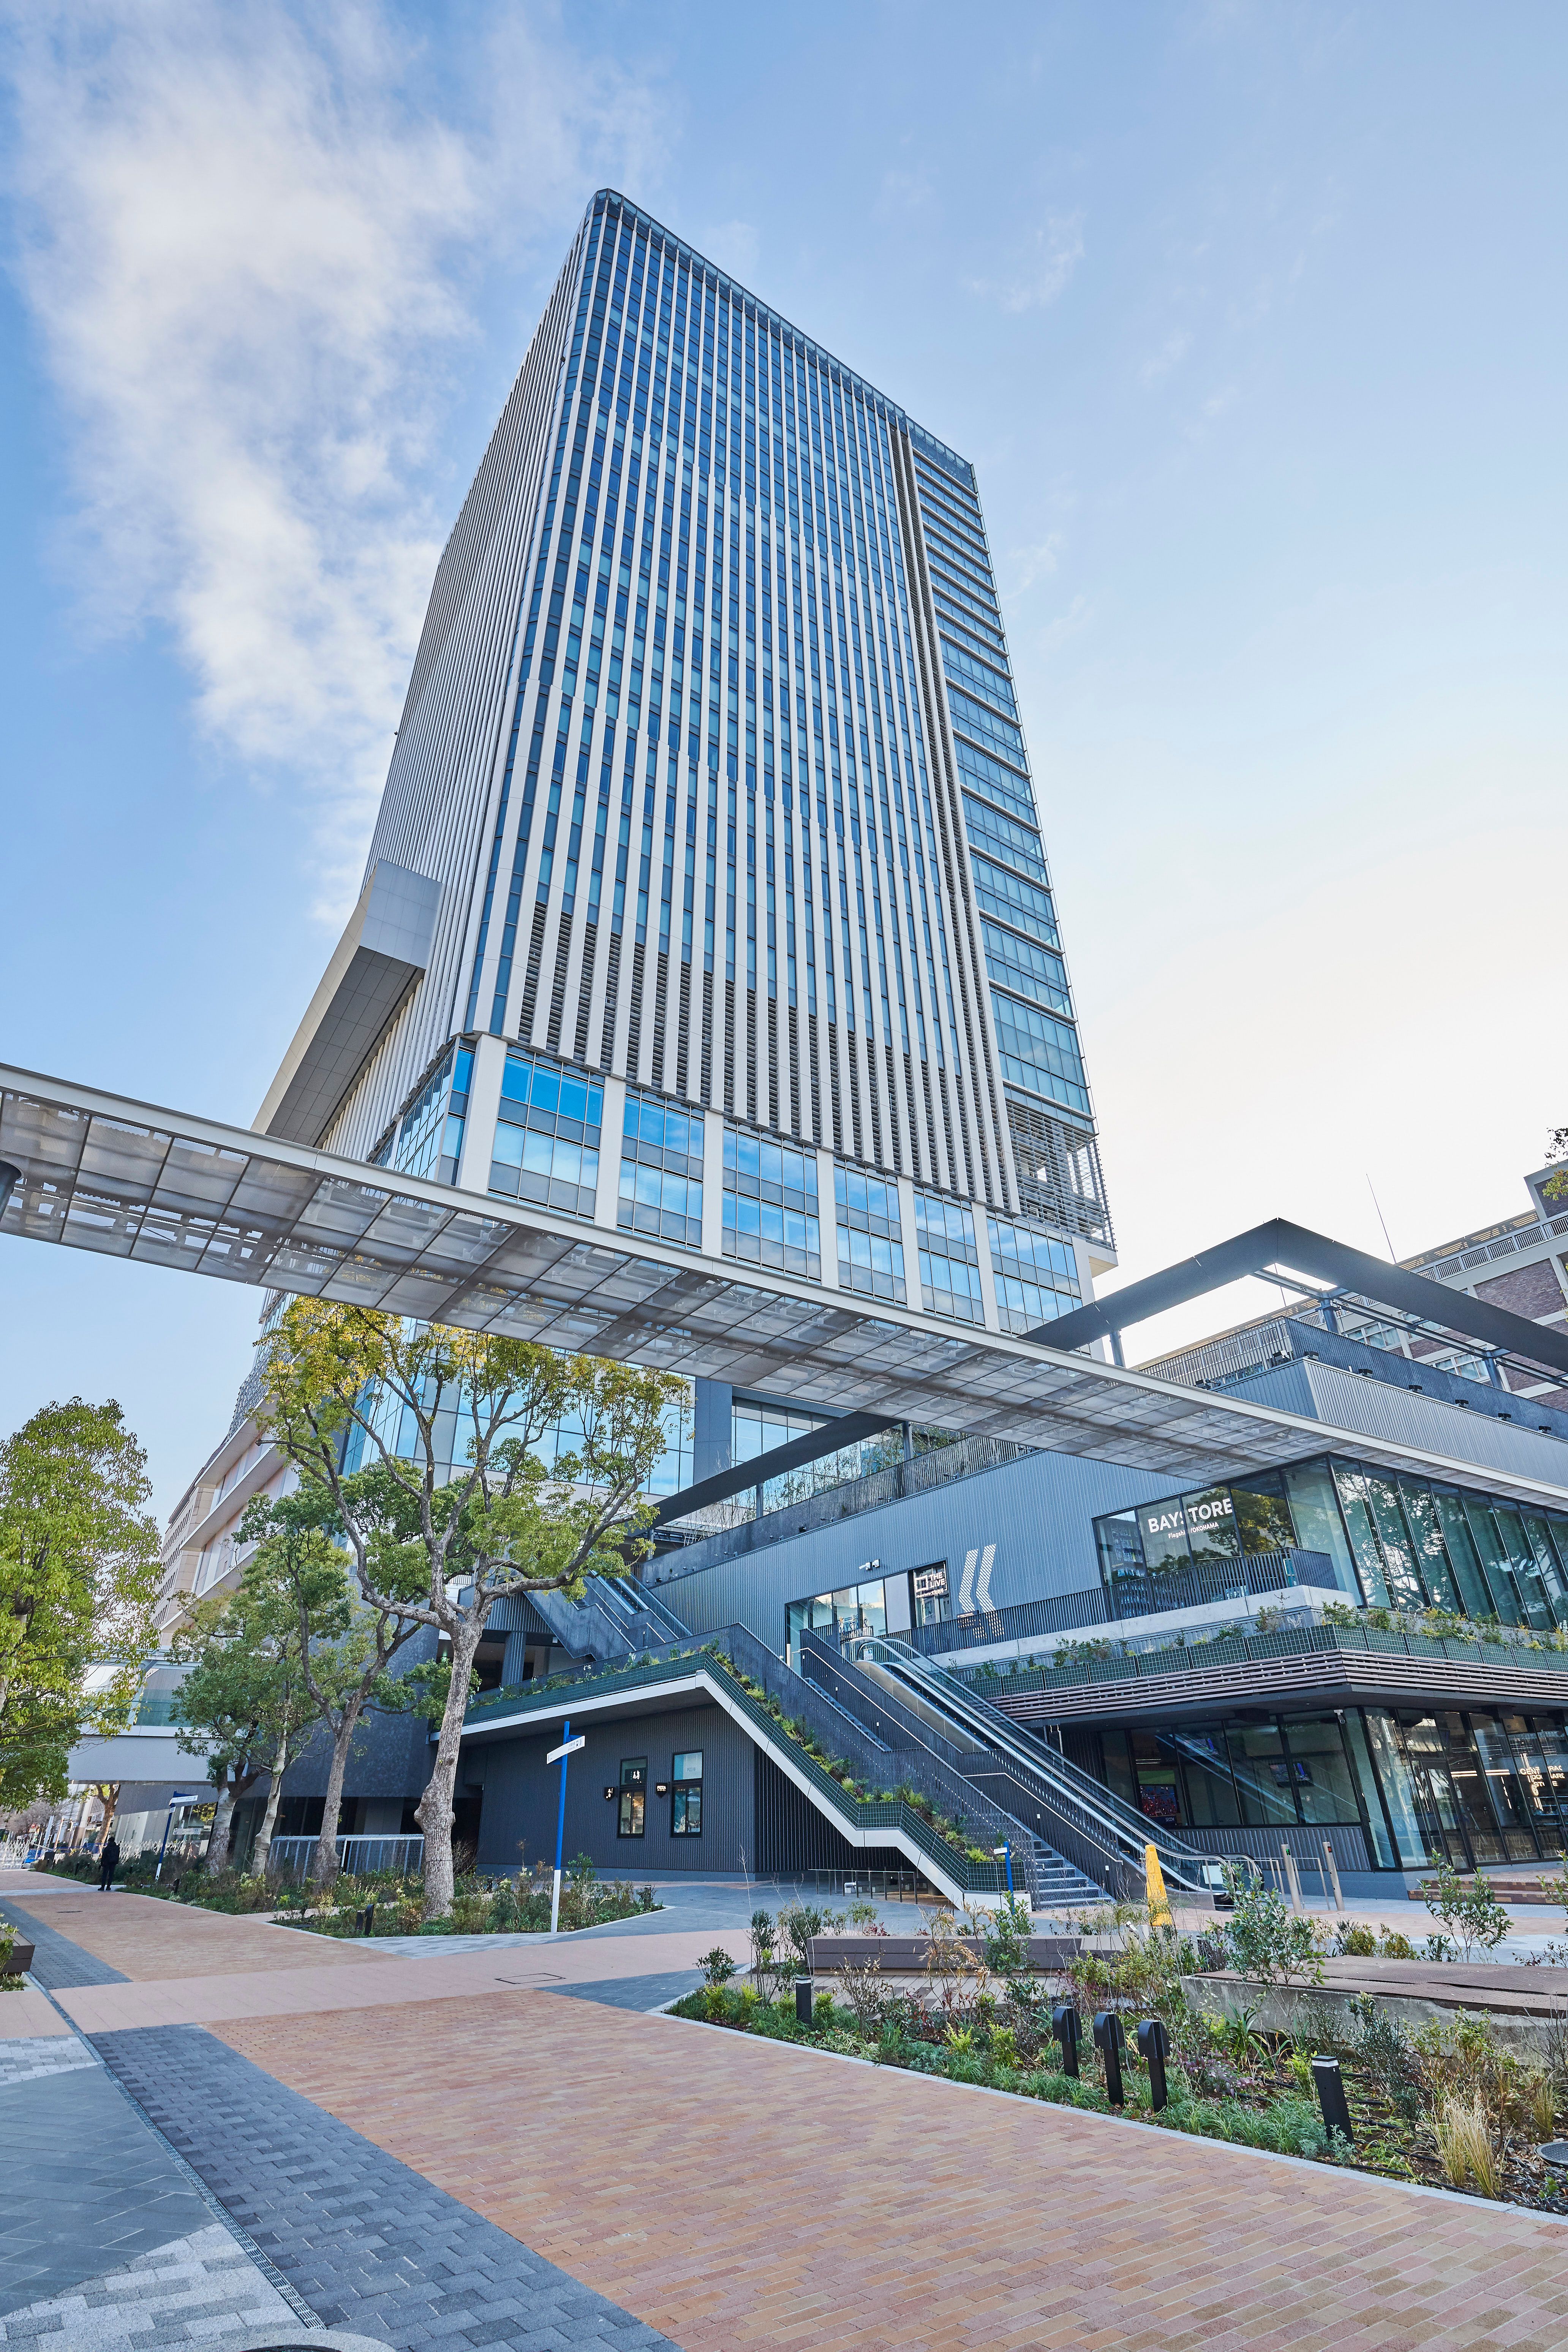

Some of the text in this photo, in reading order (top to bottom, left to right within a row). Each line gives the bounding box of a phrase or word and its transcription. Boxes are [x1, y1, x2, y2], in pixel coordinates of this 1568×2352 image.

[1168, 1530, 1186, 1538] Flagshi
[929, 1572, 943, 1581] THE
[930, 1578, 945, 1588] LIVE
[838, 1617, 868, 1633] BAYSTAS
